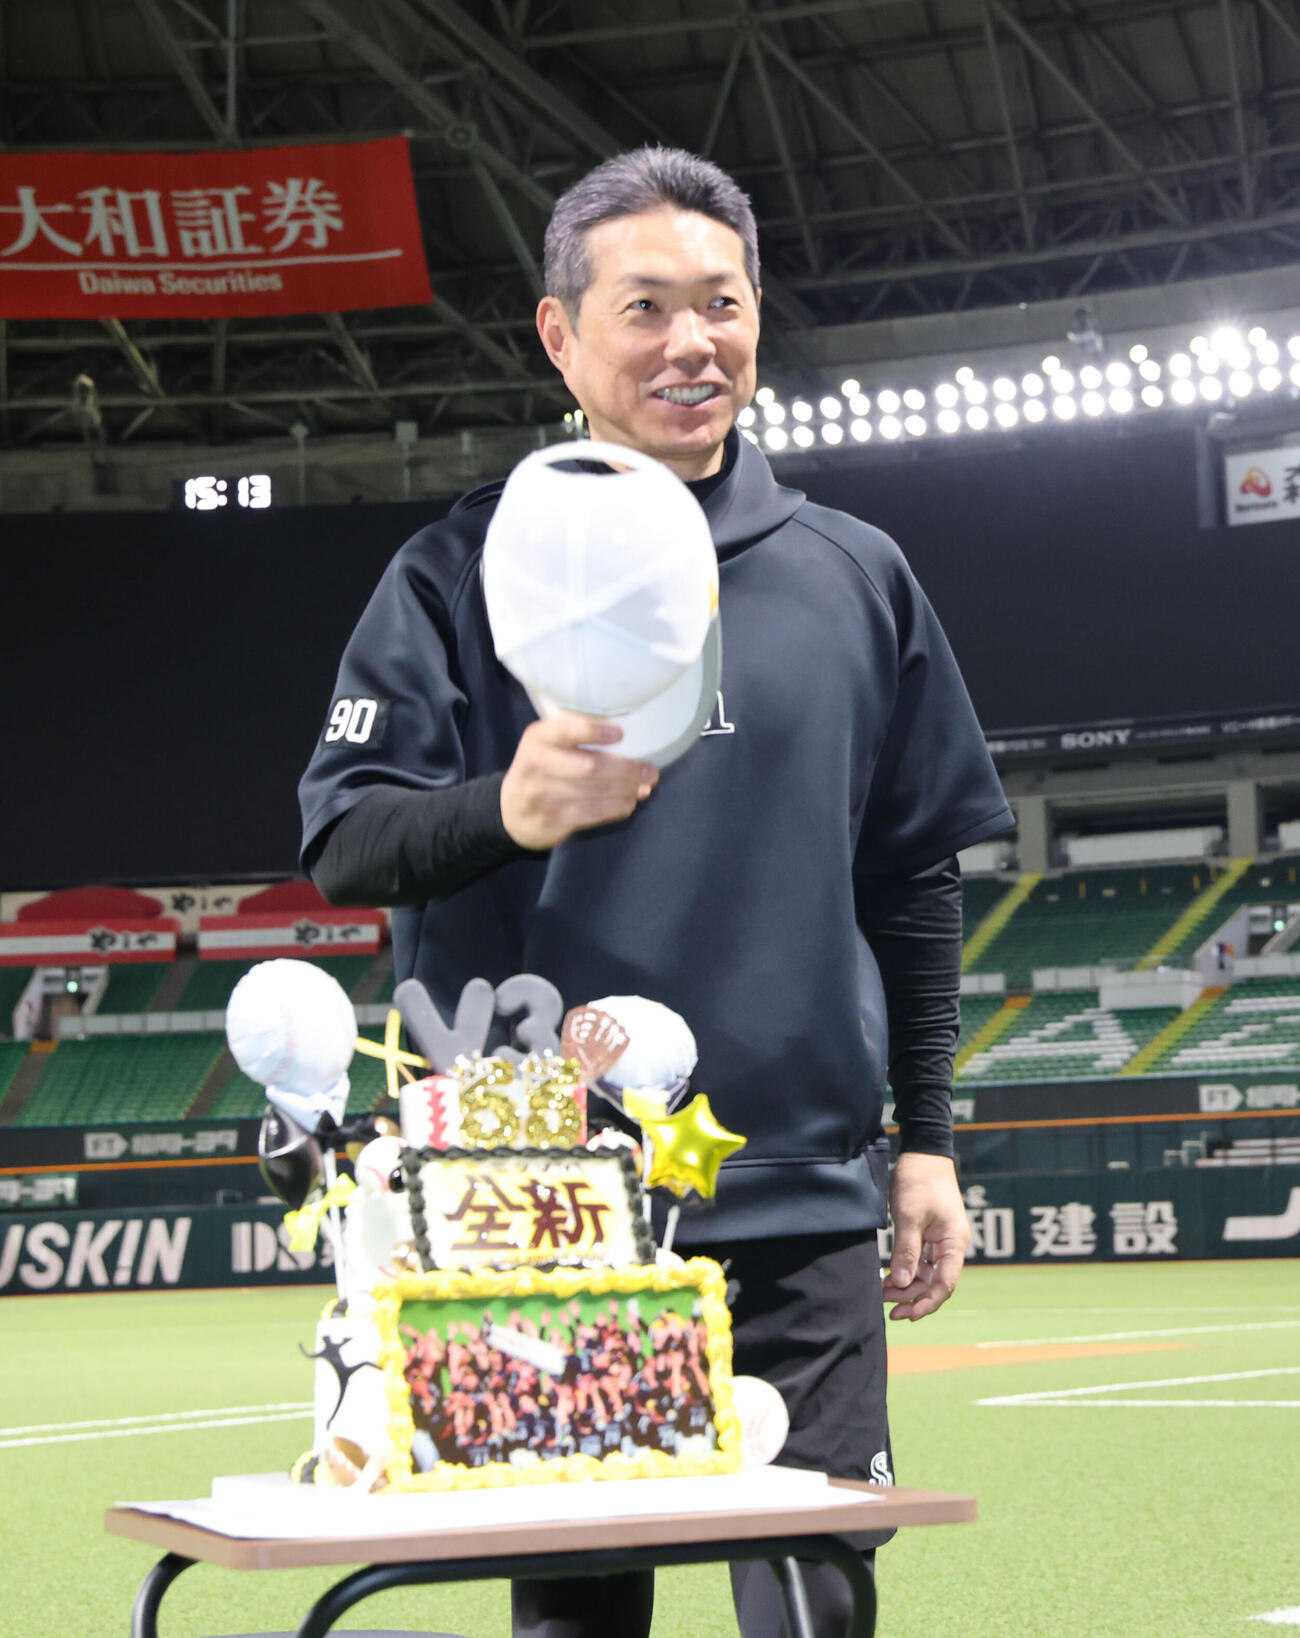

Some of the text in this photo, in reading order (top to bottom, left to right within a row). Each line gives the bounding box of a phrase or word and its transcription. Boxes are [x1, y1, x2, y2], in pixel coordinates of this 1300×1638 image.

[0, 178, 343, 258] 大和証券
[78, 271, 284, 295] Daiwa Securities
[325, 698, 378, 744] 90
[1060, 728, 1132, 750] SONY
[444, 1174, 612, 1251] 全新
[878, 1202, 1179, 1260] 和建設
